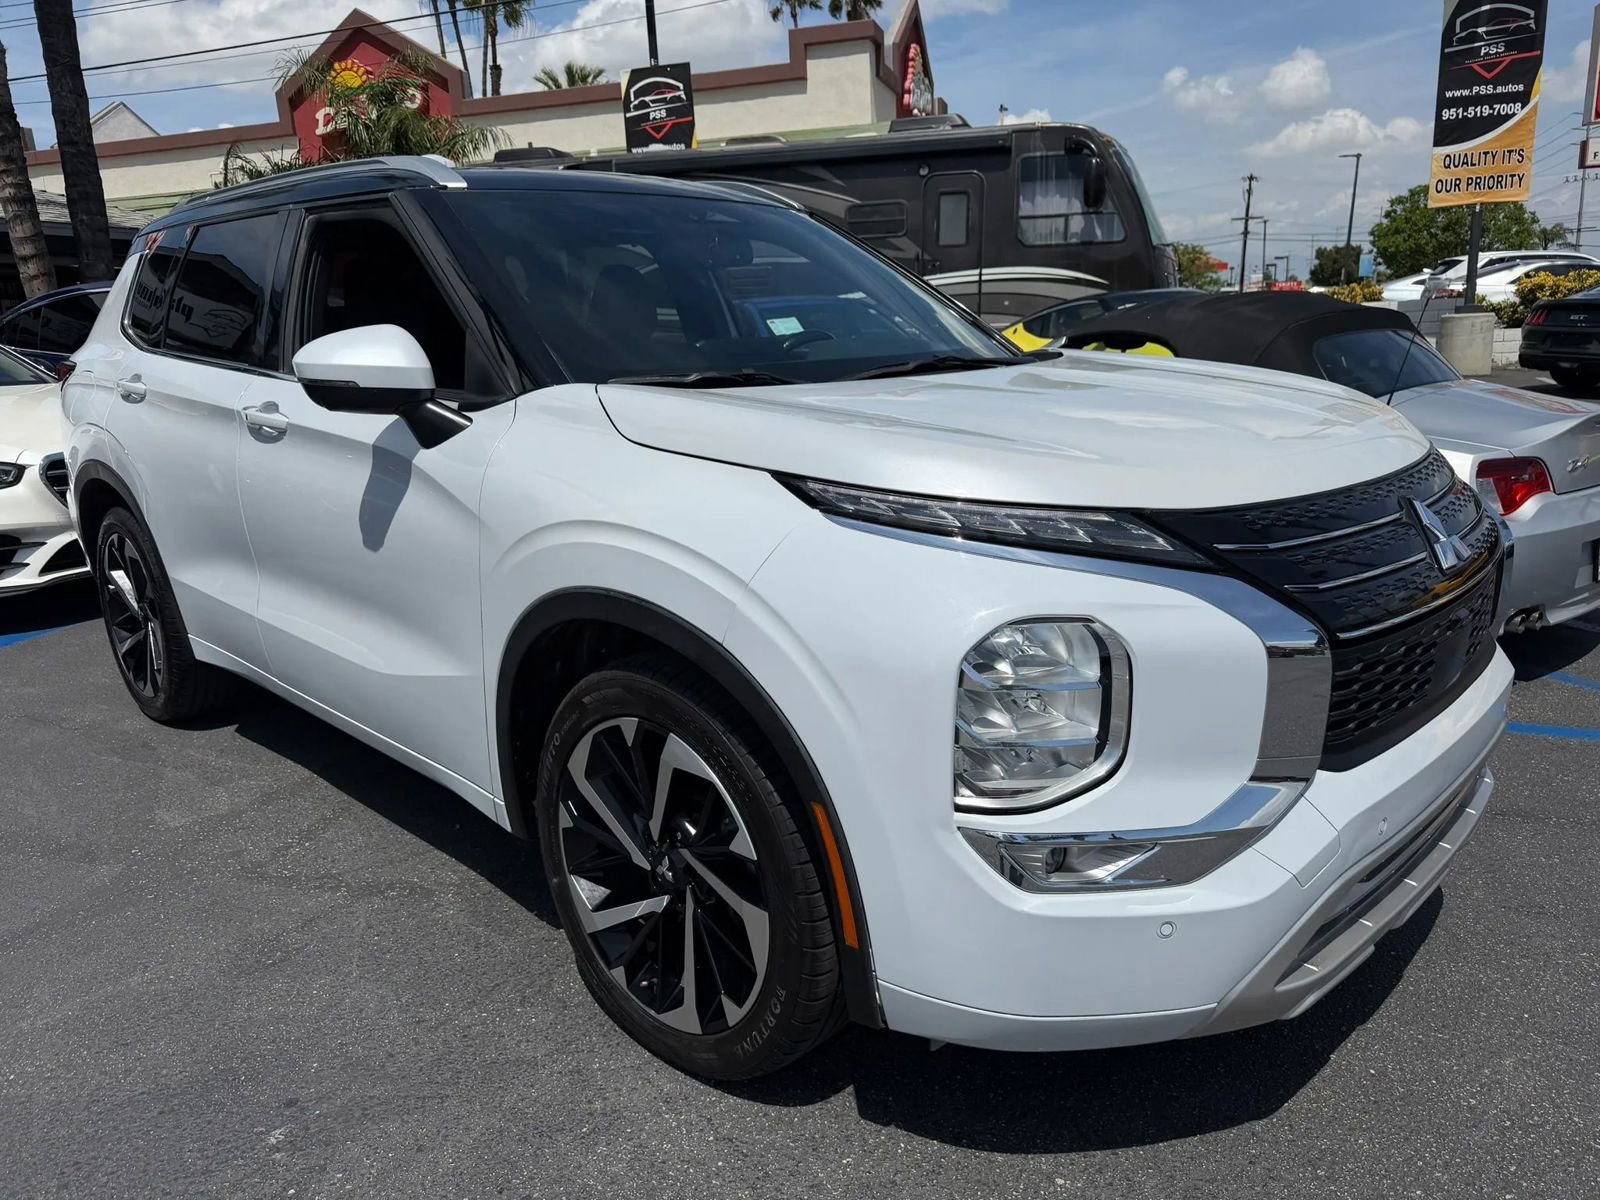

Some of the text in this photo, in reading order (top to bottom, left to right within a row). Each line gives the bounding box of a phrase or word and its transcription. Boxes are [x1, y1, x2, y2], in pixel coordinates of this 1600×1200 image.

[1480, 42, 1506, 56] PSS
[1445, 83, 1525, 98] www.PSS.autos
[649, 108, 667, 121] PSS
[1441, 102, 1522, 121] 951-519-7008
[1442, 148, 1526, 169] QUALITY IT'S
[1434, 172, 1526, 194] OUR PRIORITY
